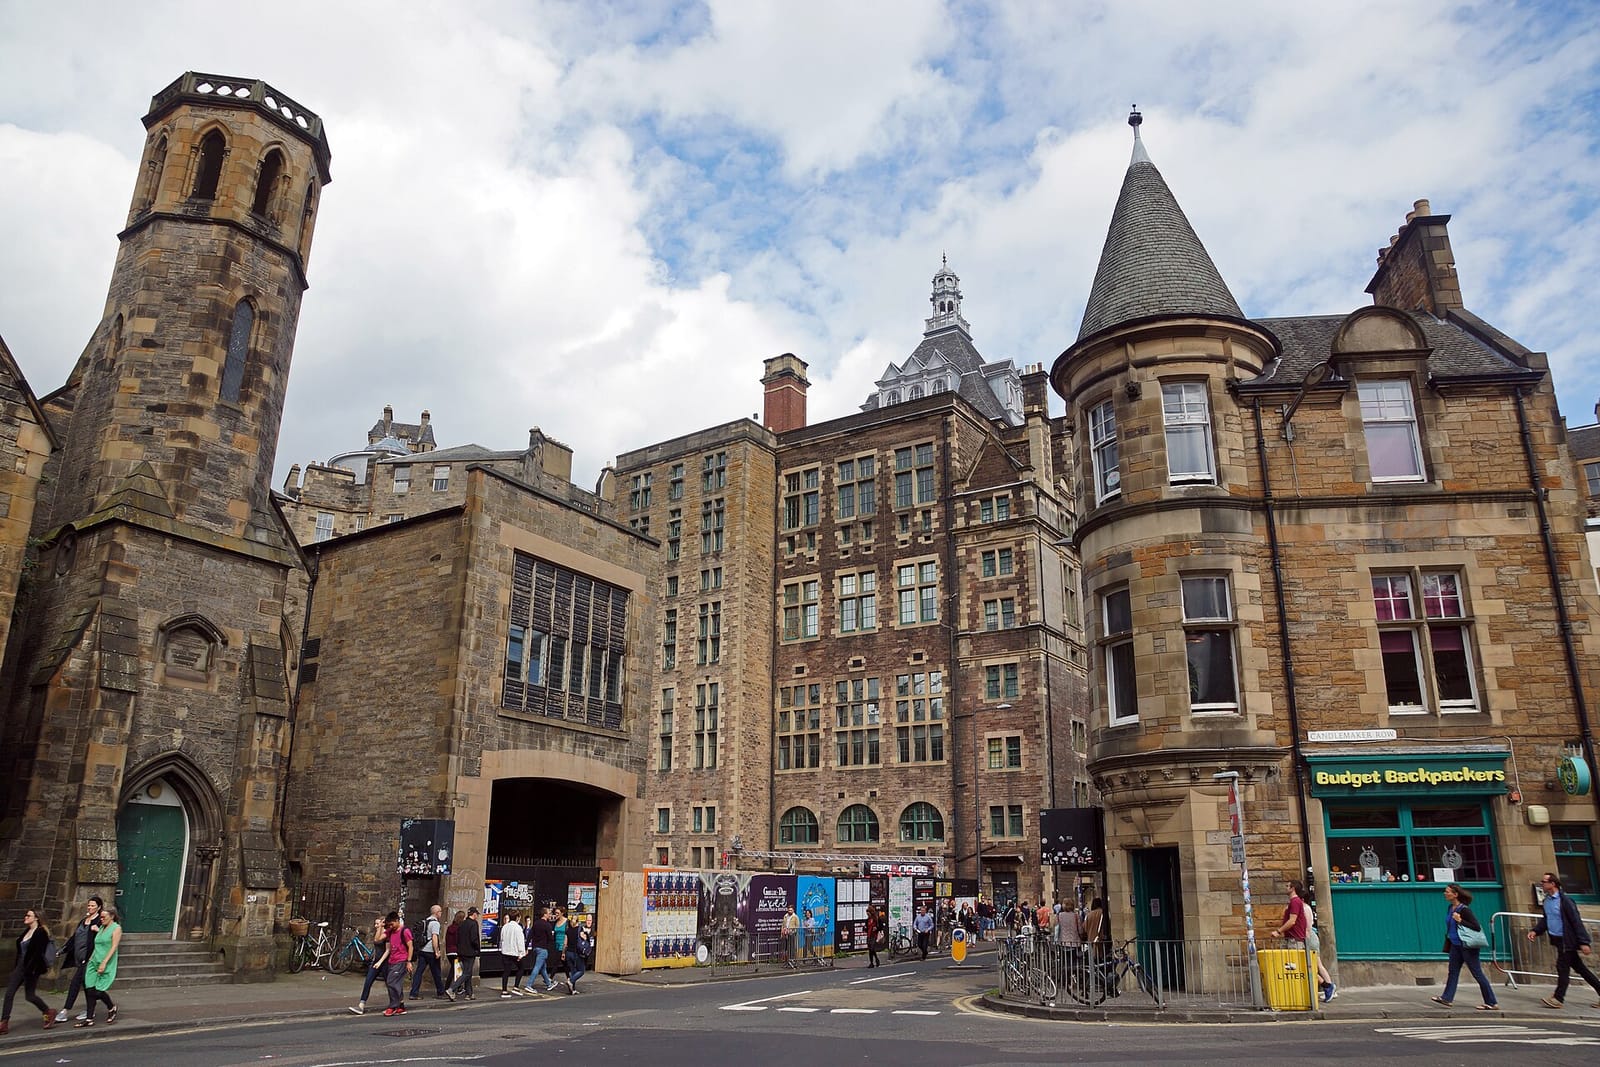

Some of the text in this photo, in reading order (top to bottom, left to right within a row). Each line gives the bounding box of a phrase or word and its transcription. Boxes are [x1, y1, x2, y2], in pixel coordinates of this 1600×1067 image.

[1310, 730, 1394, 741] CANDLEMAKER ROW
[1316, 767, 1505, 787] Budget Backpackers
[1277, 972, 1305, 980] LTTER
